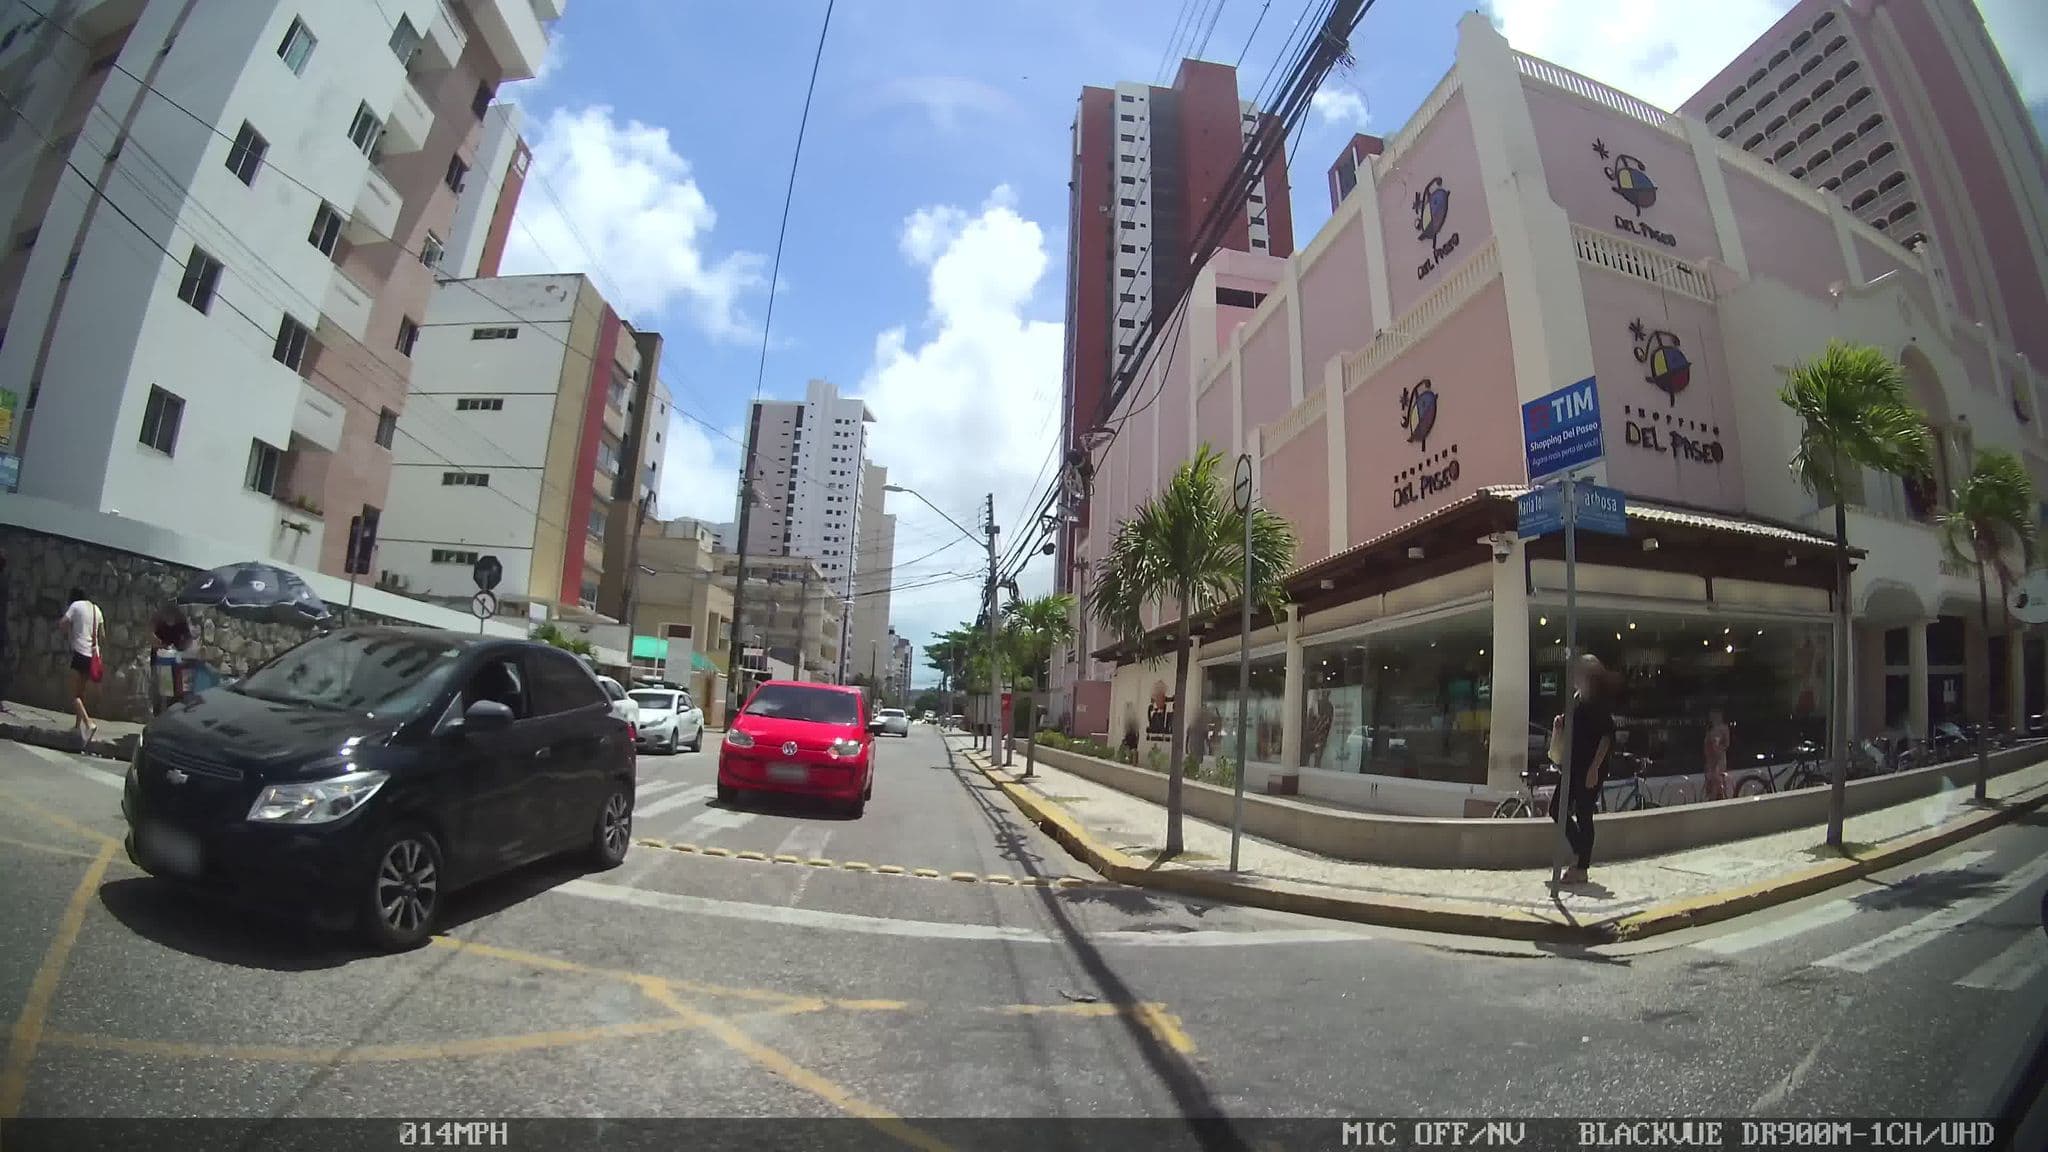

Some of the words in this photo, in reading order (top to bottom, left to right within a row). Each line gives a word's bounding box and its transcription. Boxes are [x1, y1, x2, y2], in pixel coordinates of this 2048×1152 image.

[1614, 214, 1641, 235] DEL
[1551, 385, 1595, 423] TIM
[1530, 434, 1562, 452] Shopping
[1562, 429, 1575, 441] Del
[1576, 422, 1599, 436] Paseo
[1625, 420, 1667, 452] DEL
[1668, 430, 1724, 464] PASEO
[1393, 481, 1419, 509] DEL
[1420, 459, 1460, 500] PASEO
